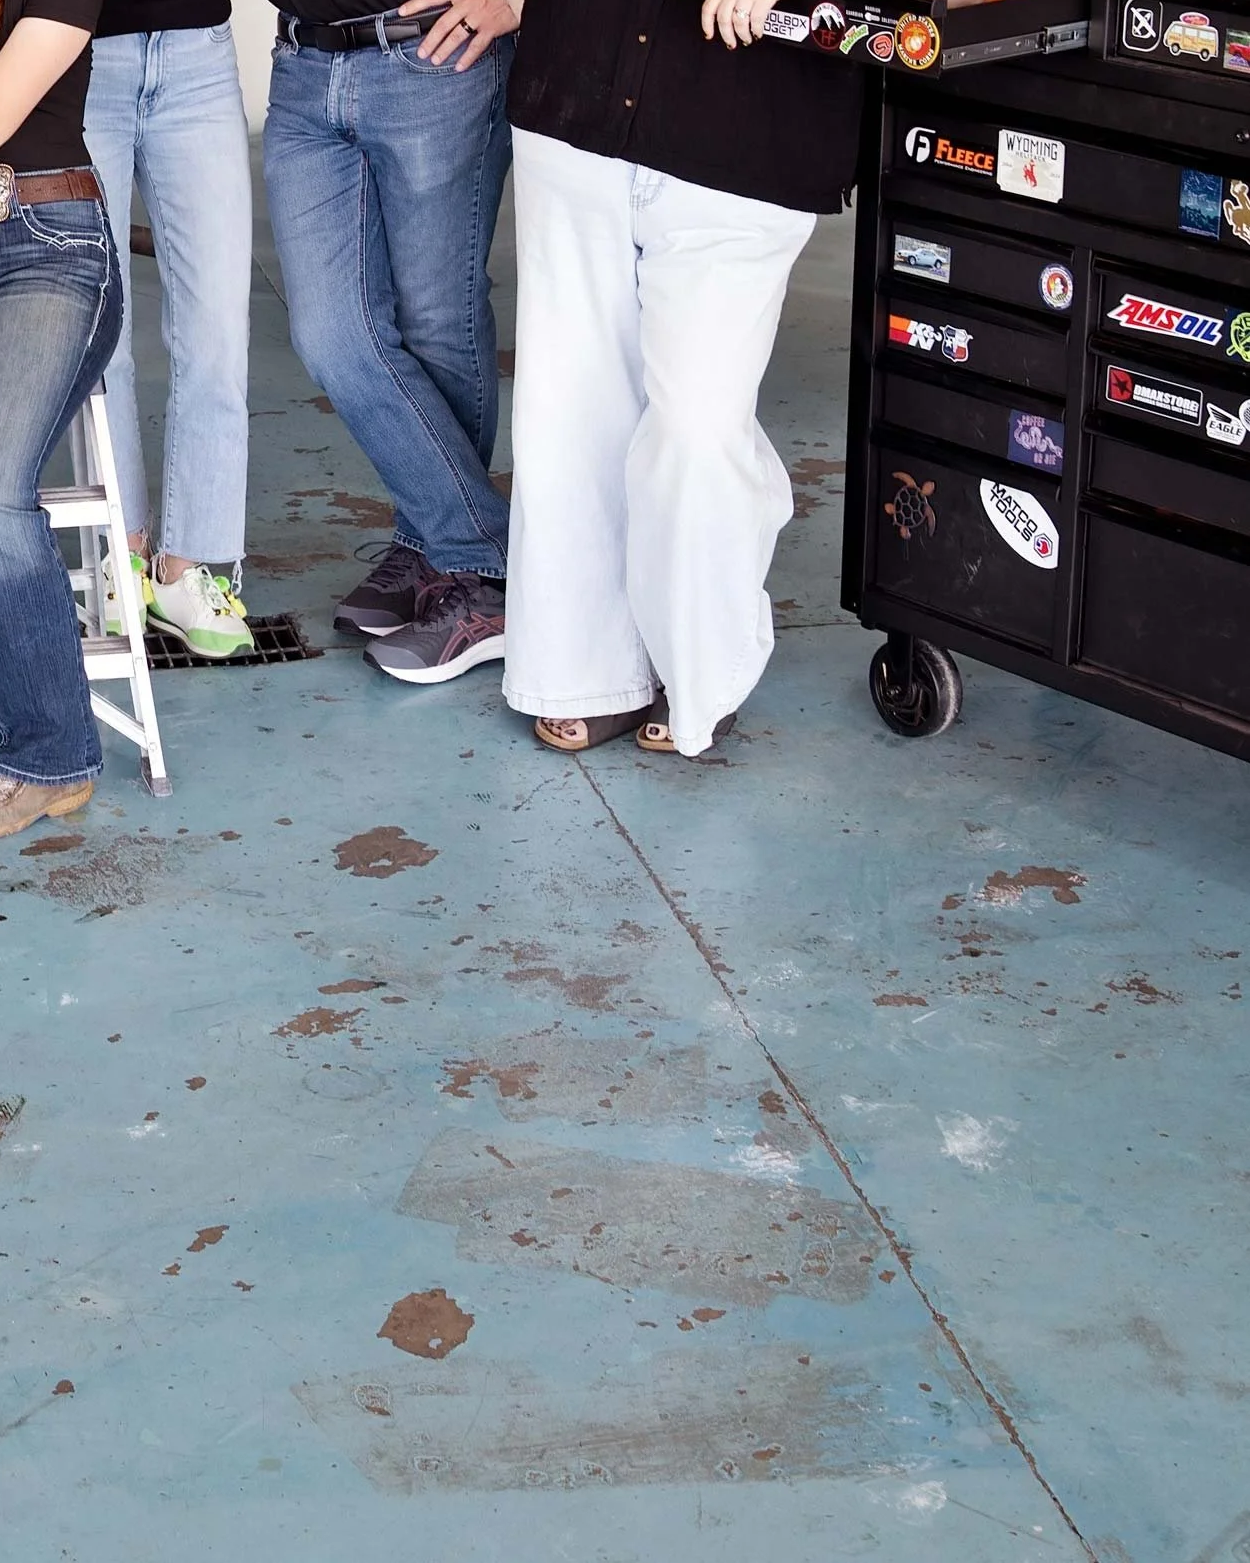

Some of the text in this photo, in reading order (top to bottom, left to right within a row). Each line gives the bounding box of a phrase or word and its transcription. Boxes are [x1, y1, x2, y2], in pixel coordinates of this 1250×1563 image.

[766, 12, 807, 29] OLBOX
[898, 14, 935, 37] UNITED STATES
[898, 43, 935, 66] MARINE CORPS
[935, 138, 994, 170] FLEECE
[1006, 133, 1058, 161] WYOMING
[1116, 298, 1218, 342] AMSOIL
[1021, 414, 1046, 428] COFFEE
[1209, 420, 1242, 437] EAGLE
[990, 488, 1033, 542] TOOLS
[992, 482, 1039, 534] MATCO
